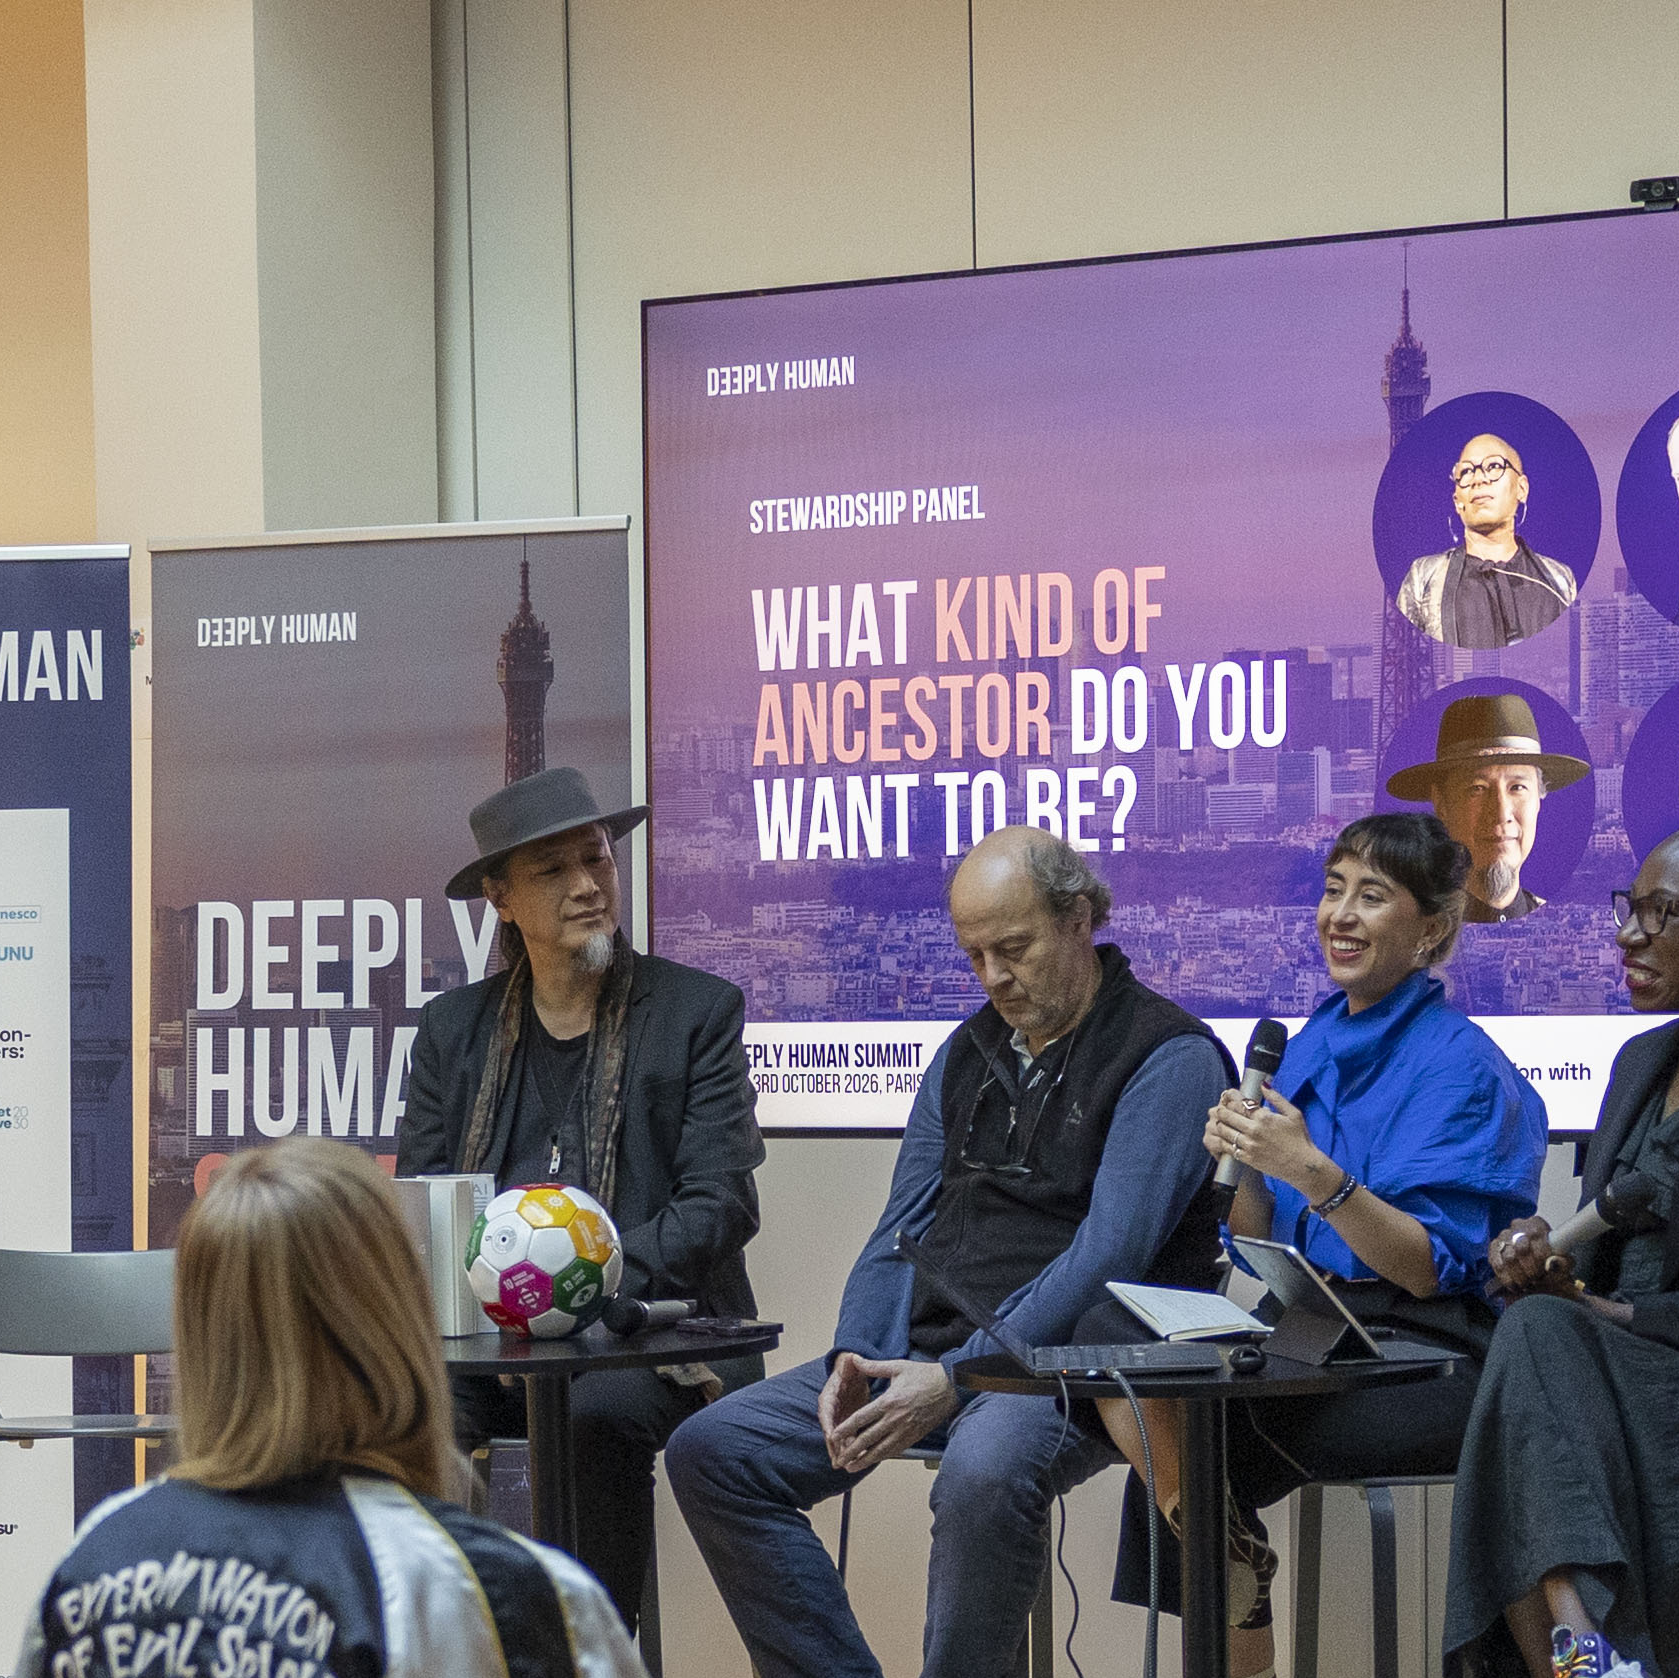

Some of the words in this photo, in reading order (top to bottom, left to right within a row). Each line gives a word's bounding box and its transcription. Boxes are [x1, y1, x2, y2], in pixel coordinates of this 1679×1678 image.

[784, 356, 856, 391] HUMAN
[749, 489, 907, 535] STEWARDSHIP
[912, 485, 985, 523] PANEL
[281, 611, 357, 644] HUMAN
[751, 579, 917, 671] WHAT
[935, 571, 1074, 663] KIND
[1092, 566, 1166, 655] OF
[752, 671, 1053, 767] ANCESTOR
[1070, 665, 1149, 755] DO
[1165, 658, 1288, 751] YOU
[753, 773, 920, 862] WANT
[933, 769, 1006, 857] TO
[1026, 764, 1138, 852] BE?
[196, 898, 499, 1010] DEEPLY
[788, 1043, 849, 1068] HUMAN
[854, 1043, 923, 1068] SUMMIT
[1548, 1063, 1591, 1081] with
[196, 1026, 420, 1137] HUMA
[782, 1073, 841, 1093] OCTOBER
[844, 1073, 882, 1095] 2026,
